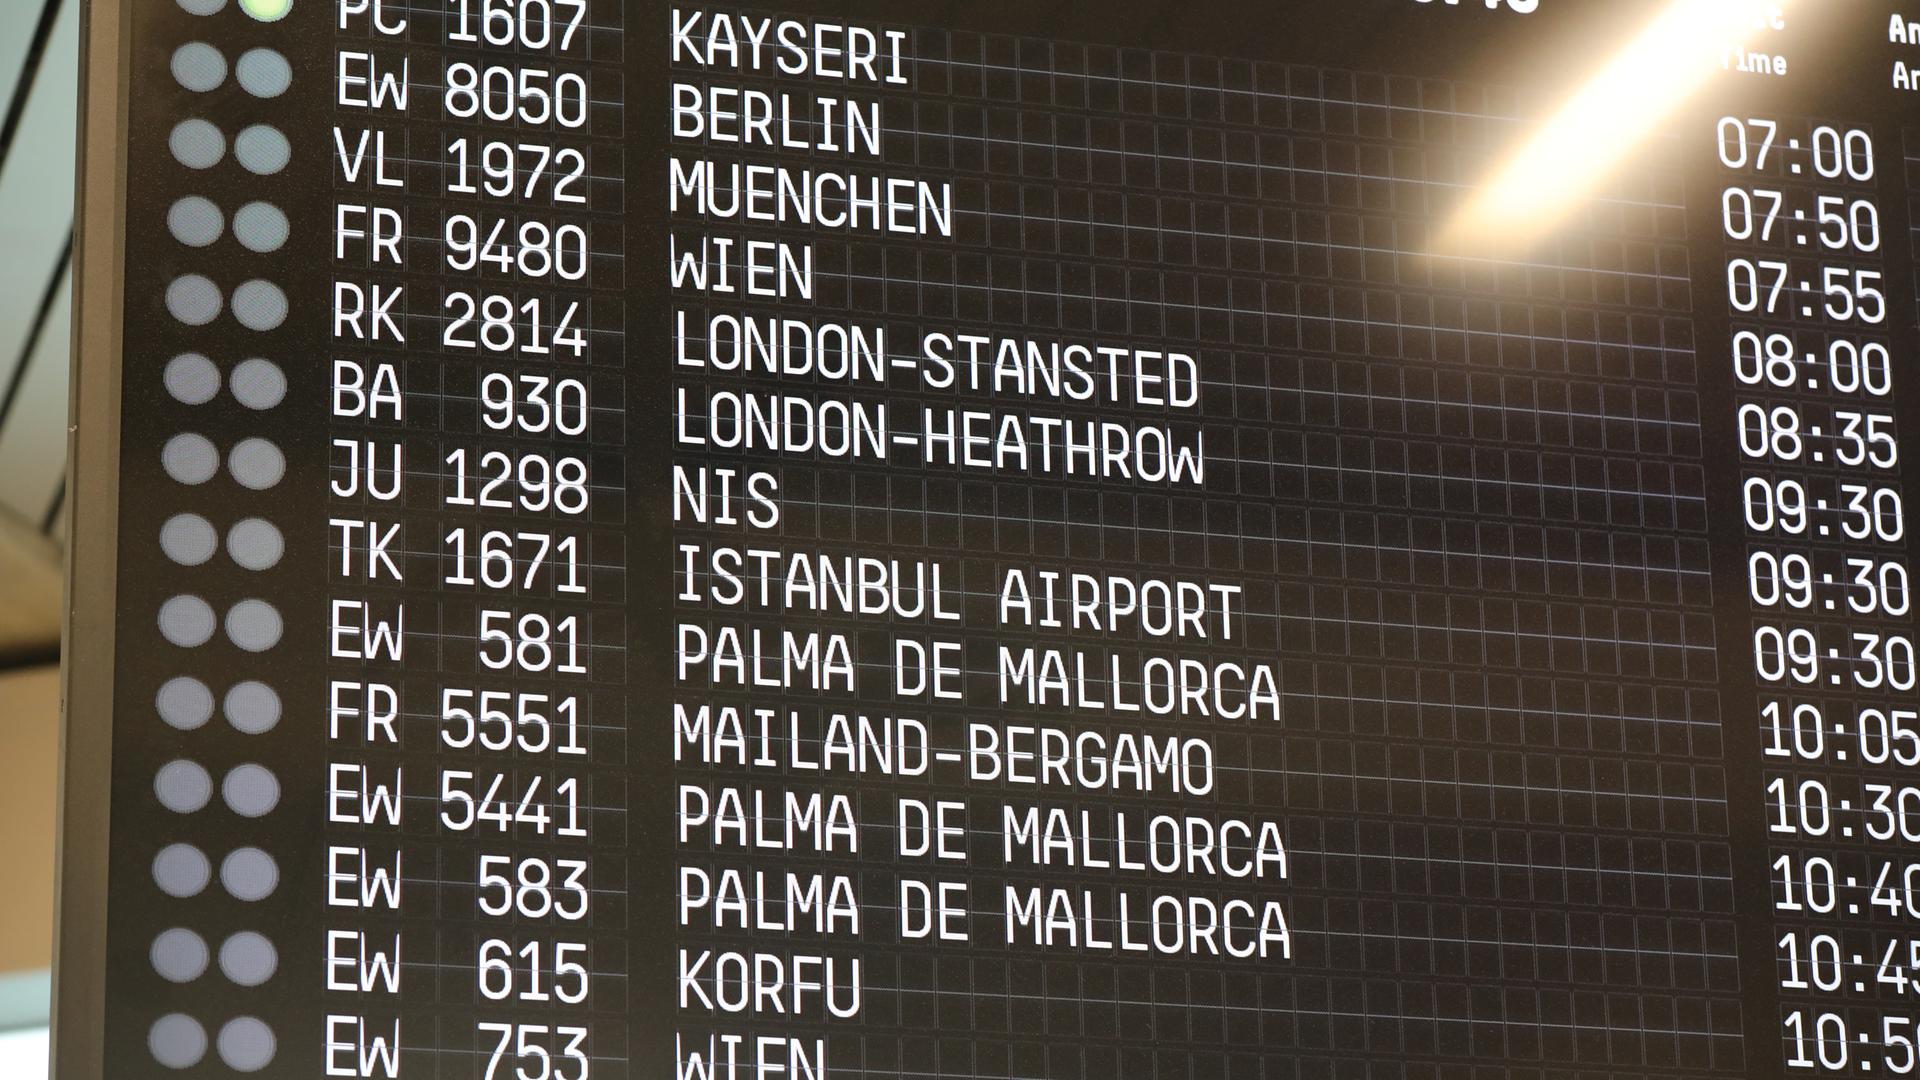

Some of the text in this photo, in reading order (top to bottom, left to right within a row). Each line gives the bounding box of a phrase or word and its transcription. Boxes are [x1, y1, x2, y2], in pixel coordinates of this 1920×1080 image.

[339, 51, 1880, 252] EW 8050 BERLIN 07:50
[340, 0, 1874, 181] PC 1607 KAYSERI 07:00
[333, 126, 1885, 324] VL 1972 MUENCHEN 07:55
[337, 204, 1892, 396] FR 9480 WIEN 08:00
[333, 359, 1904, 542] BA 930 LONDON-HEATHROW 09:30
[334, 281, 1897, 469] RK 2814 LONDON-STANSTED 08:35
[329, 518, 1916, 691] TK 1671 ISTANBUL AIRPORT 09:30
[331, 439, 1910, 616] JU 1298 NIS 09:30
[330, 680, 1920, 842] FR 5551 MAILAND-BERGAMO 10:30
[331, 599, 1920, 766] EW 581 PALMA DE MALLORCA 10:05
[328, 846, 401, 909] EW
[478, 855, 588, 920] 583
[680, 866, 859, 935] PALMA
[900, 879, 969, 941] DE
[1005, 885, 1291, 959] MALLORCA
[329, 763, 401, 826] EW
[440, 770, 587, 837] 5441
[680, 785, 857, 853] PALMA
[899, 798, 966, 860] DE
[1003, 805, 1287, 879] MALLORCA
[326, 1014, 824, 1080] EW 753 WIEN
[327, 930, 1920, 1074] EW 615 KORFU 10:5
